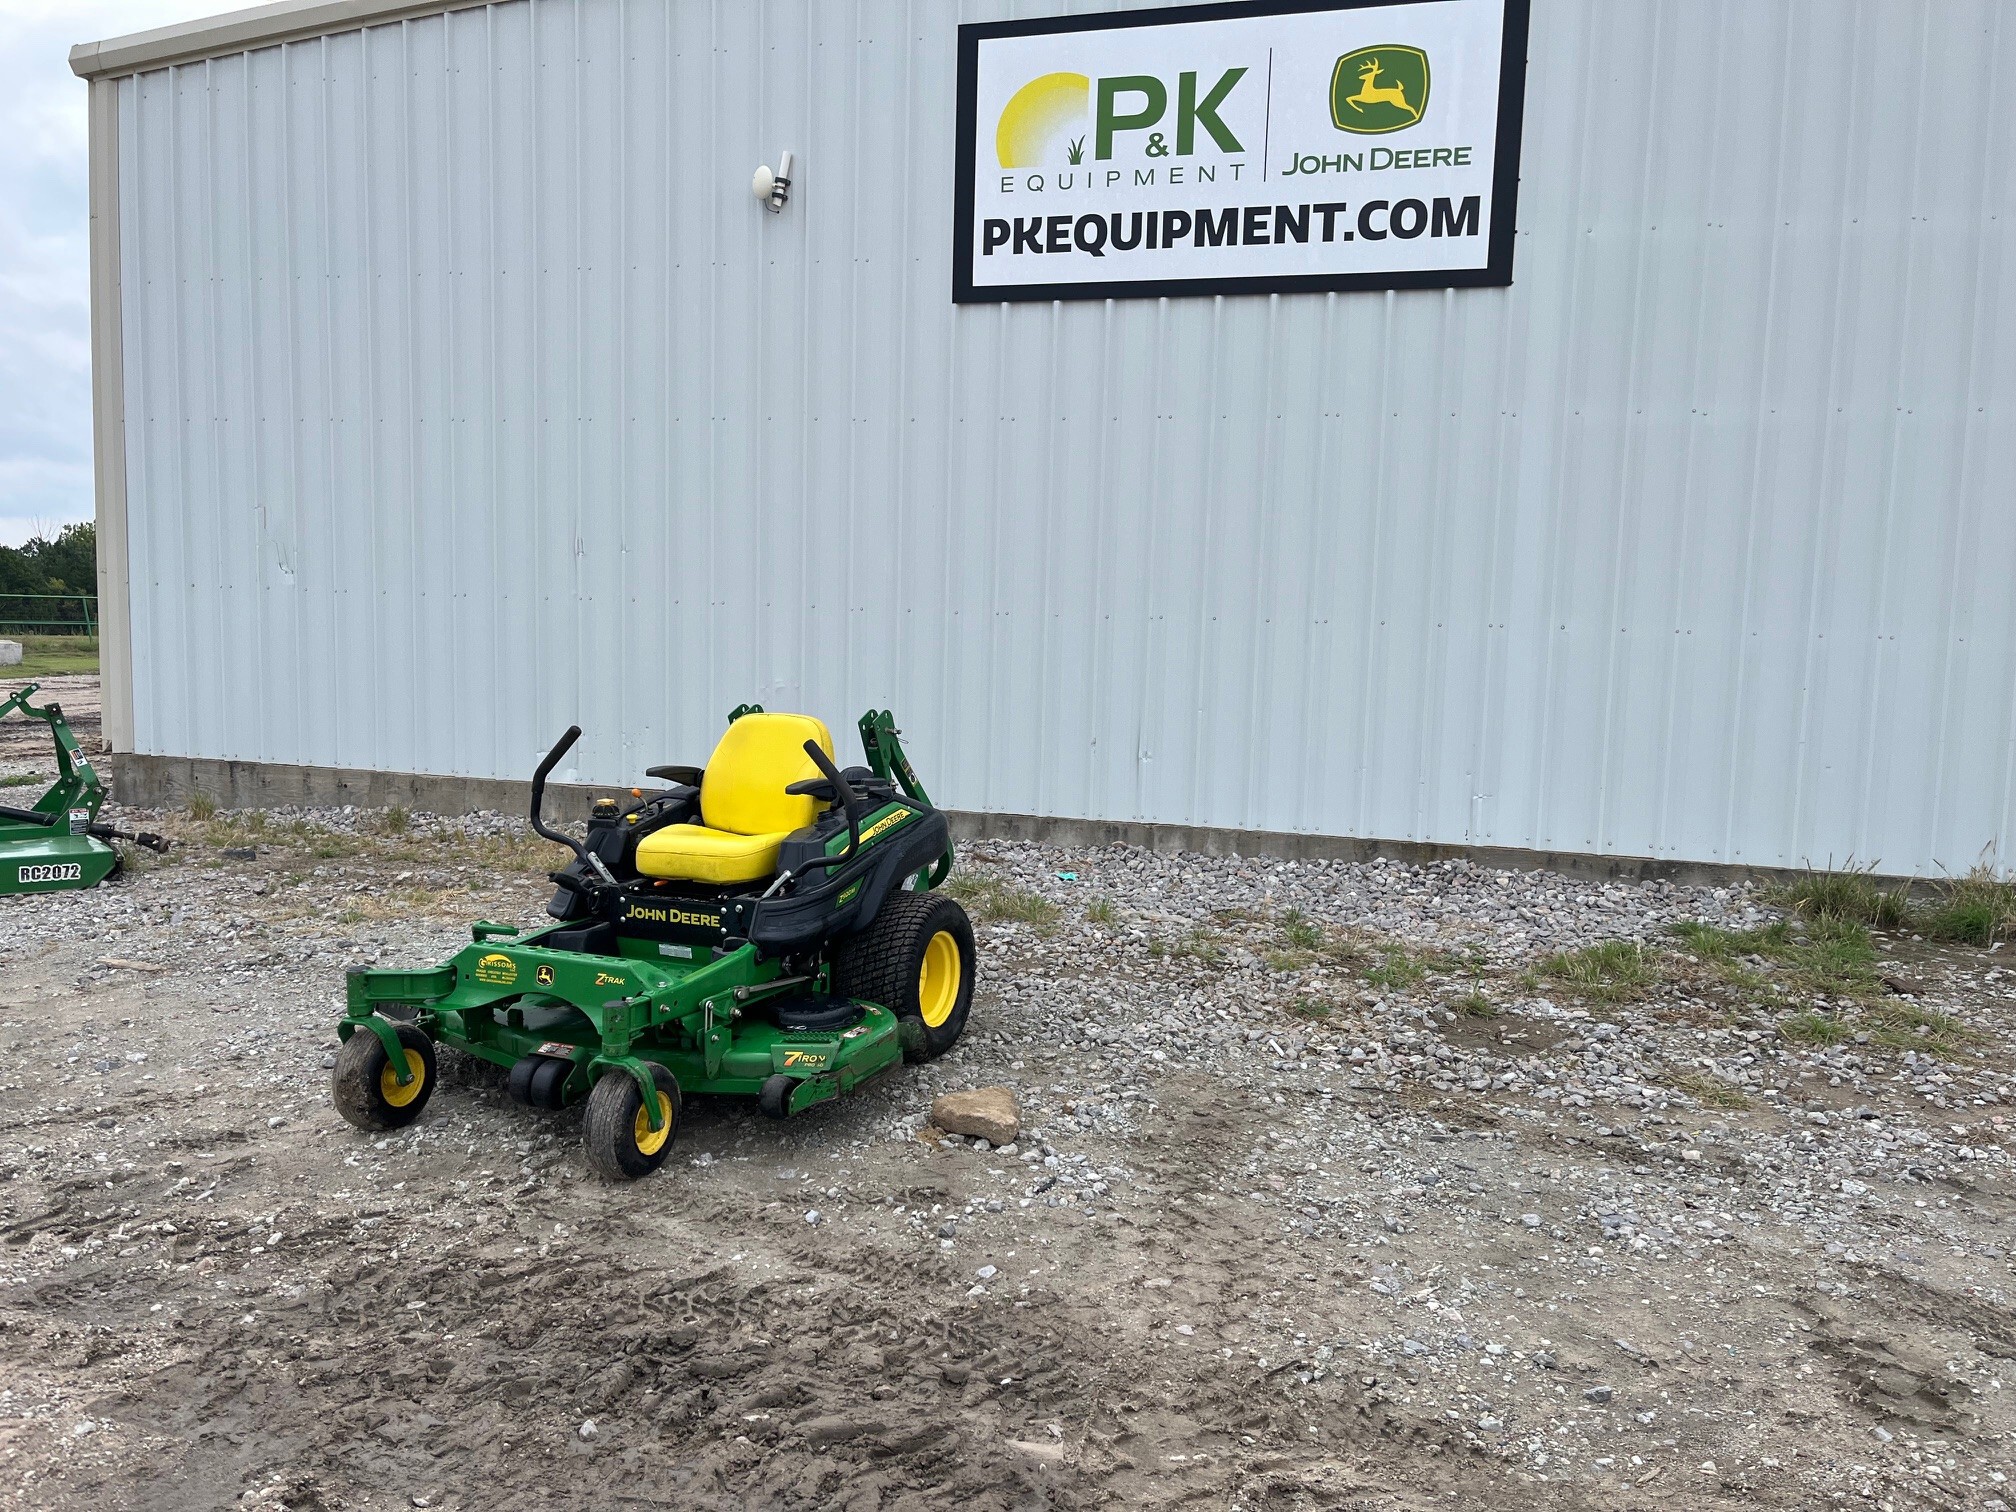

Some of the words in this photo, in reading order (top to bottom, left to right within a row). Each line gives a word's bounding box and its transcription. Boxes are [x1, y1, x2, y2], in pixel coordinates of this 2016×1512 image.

[1095, 67, 1249, 160] P&K
[1282, 151, 1363, 176] JOHN
[1370, 146, 1473, 171] DEERE
[1001, 163, 1245, 193] EQUIPMENT
[982, 195, 1481, 257] PKEQUIPMENT.COM
[872, 822, 886, 836] JOHN
[886, 812, 905, 825] DEERE
[19, 864, 81, 882] RC2072
[626, 904, 666, 922] JOHN
[669, 909, 721, 928] DEERE
